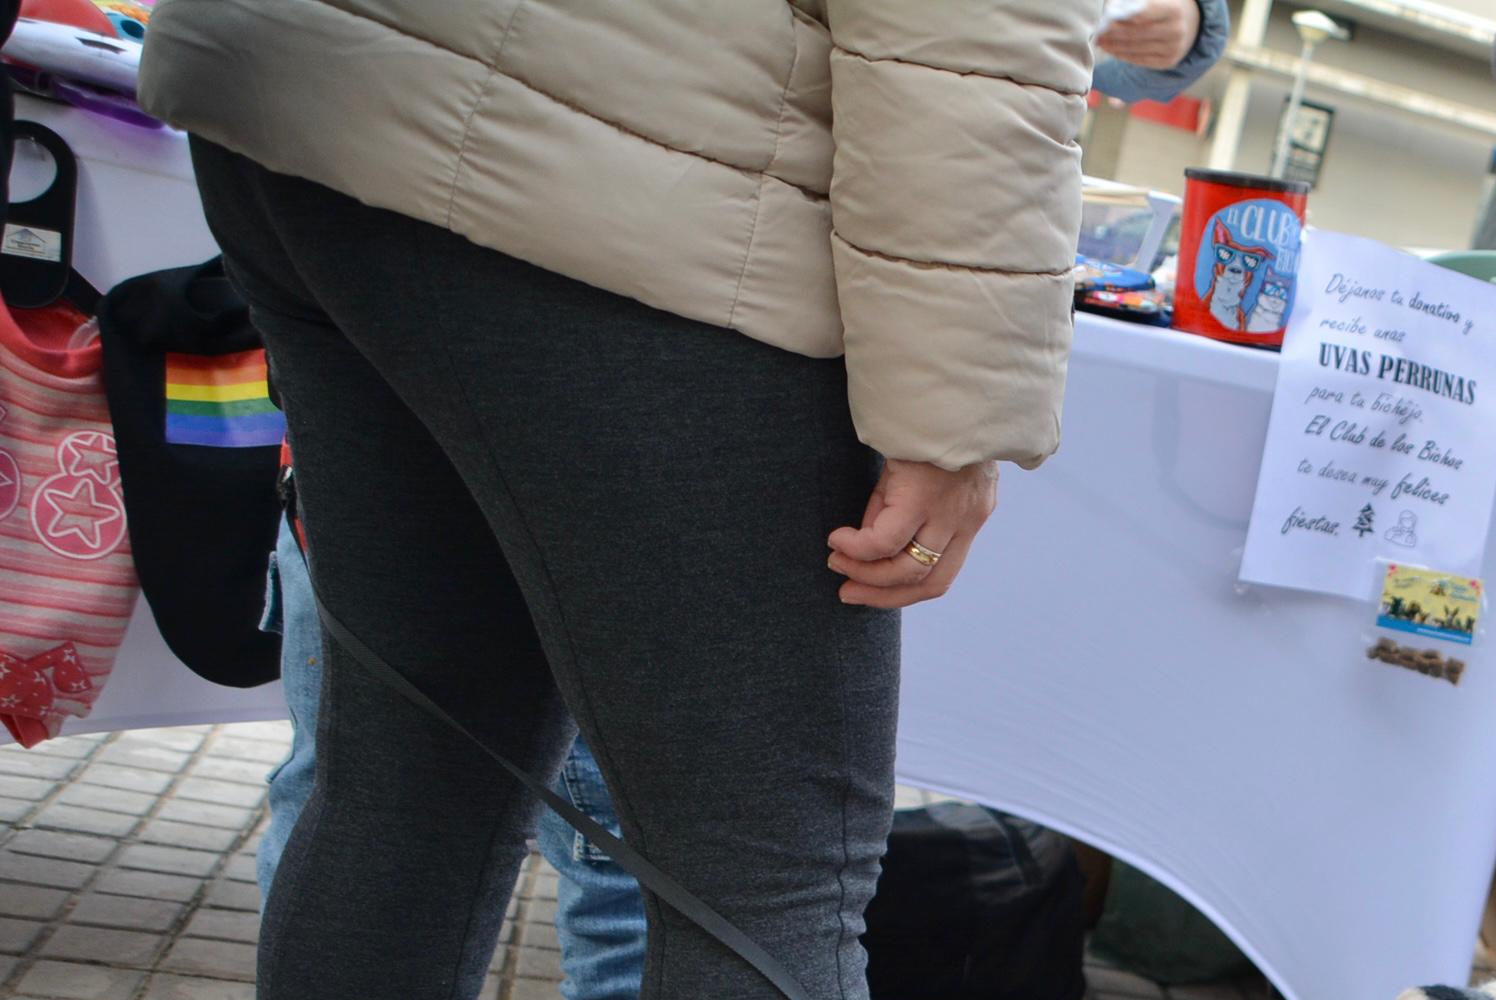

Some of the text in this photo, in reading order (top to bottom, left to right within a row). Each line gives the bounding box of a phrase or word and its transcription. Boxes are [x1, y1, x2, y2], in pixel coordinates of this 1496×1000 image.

[1241, 205, 1292, 246] CLUB
[1325, 273, 1385, 302] Déjanos
[1408, 292, 1461, 323] donativo
[1462, 319, 1474, 335] y
[1320, 316, 1406, 342] recibe unas
[1304, 386, 1344, 404] para
[1318, 342, 1477, 405] UVAS PERRUNAS
[1304, 414, 1463, 470] El Club de los Bichos
[1297, 458, 1450, 505] te desea muy felices
[1280, 506, 1340, 536] fiestas.
